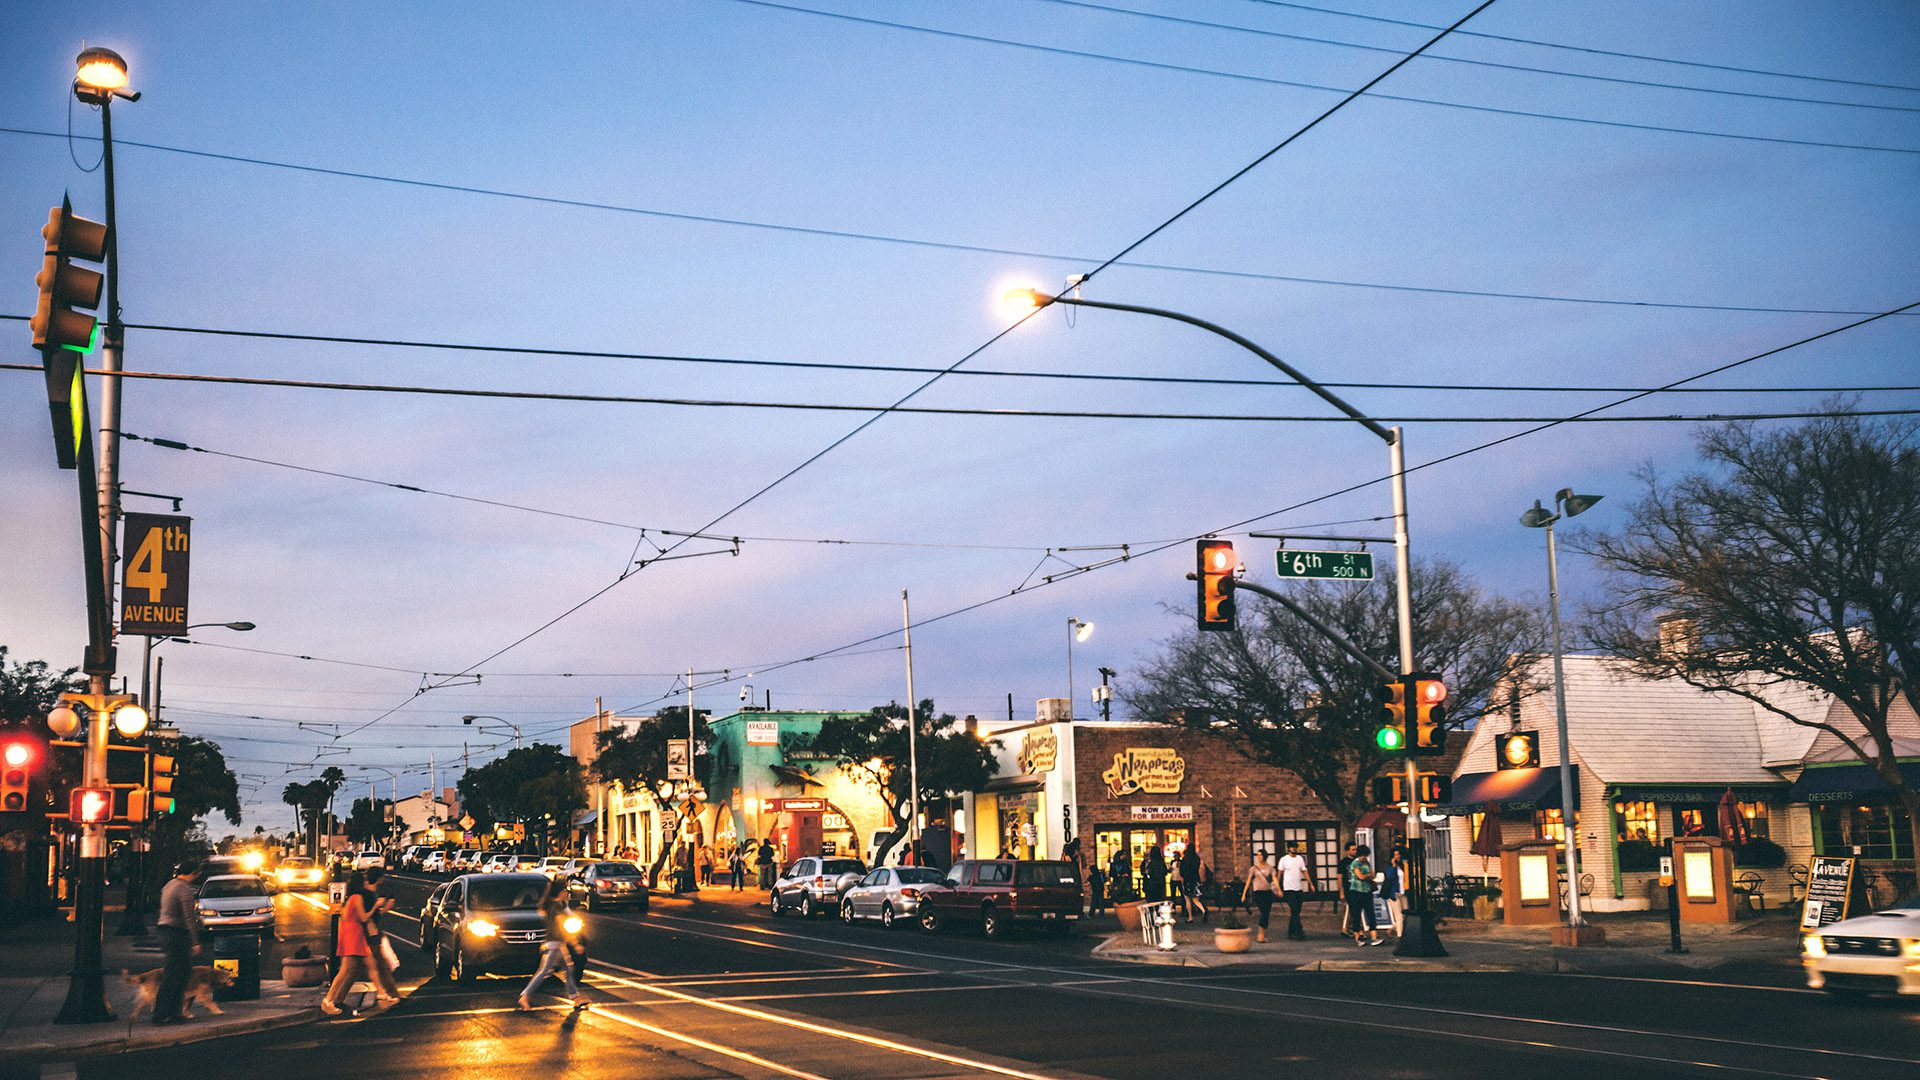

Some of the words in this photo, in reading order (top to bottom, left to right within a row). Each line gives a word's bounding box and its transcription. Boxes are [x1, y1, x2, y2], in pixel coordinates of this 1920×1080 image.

[126, 526, 188, 603] 4th
[1282, 552, 1289, 563] E
[1293, 553, 1322, 574] 6th
[1343, 554, 1355, 565] St
[1333, 566, 1354, 577] 500
[1360, 567, 1368, 577] N
[124, 605, 184, 623] AVENUE
[748, 722, 777, 731] AVAILABLE
[1151, 781, 1166, 789] juice
[1640, 793, 1684, 802] ESPRESSO
[1808, 791, 1854, 801] DESSERTS
[662, 821, 675, 829] 25
[1063, 804, 1072, 843] 500
[1818, 864, 1849, 876] AVENUE
